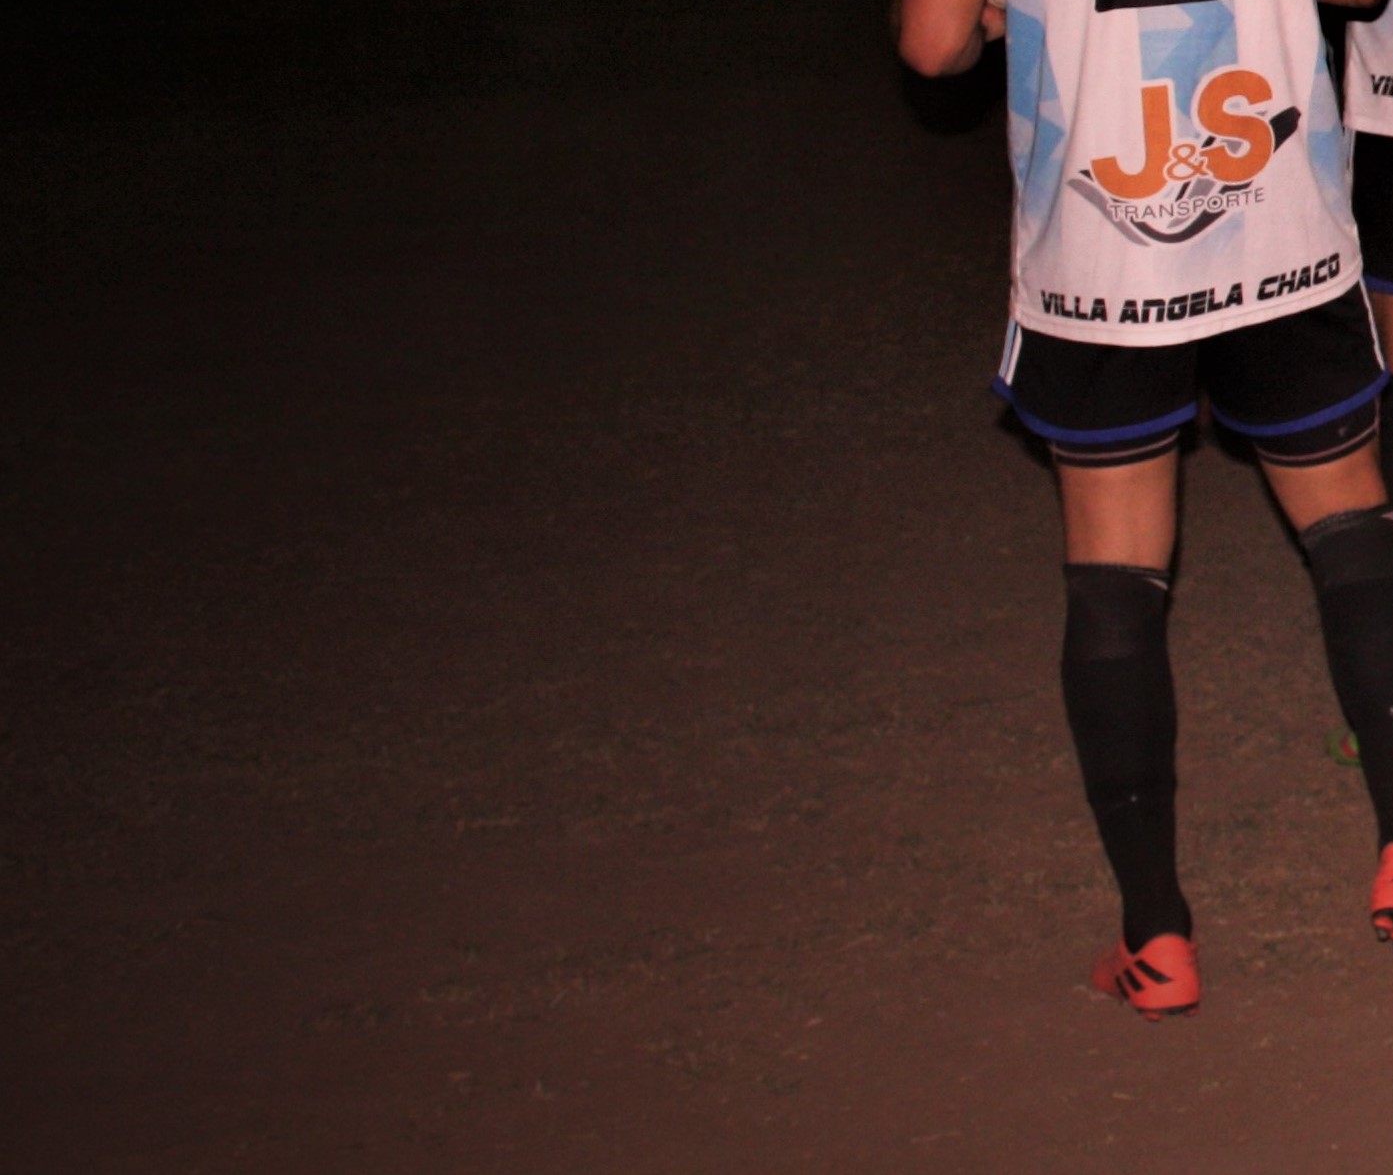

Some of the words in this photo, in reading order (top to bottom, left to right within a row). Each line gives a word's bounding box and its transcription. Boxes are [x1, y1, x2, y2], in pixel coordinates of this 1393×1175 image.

[1091, 70, 1274, 200] J&S
[1110, 187, 1265, 220] TRANSPORTE
[1041, 289, 1107, 321] VILLA
[1119, 282, 1244, 324] ANGELA
[1257, 252, 1341, 300] CHACO
